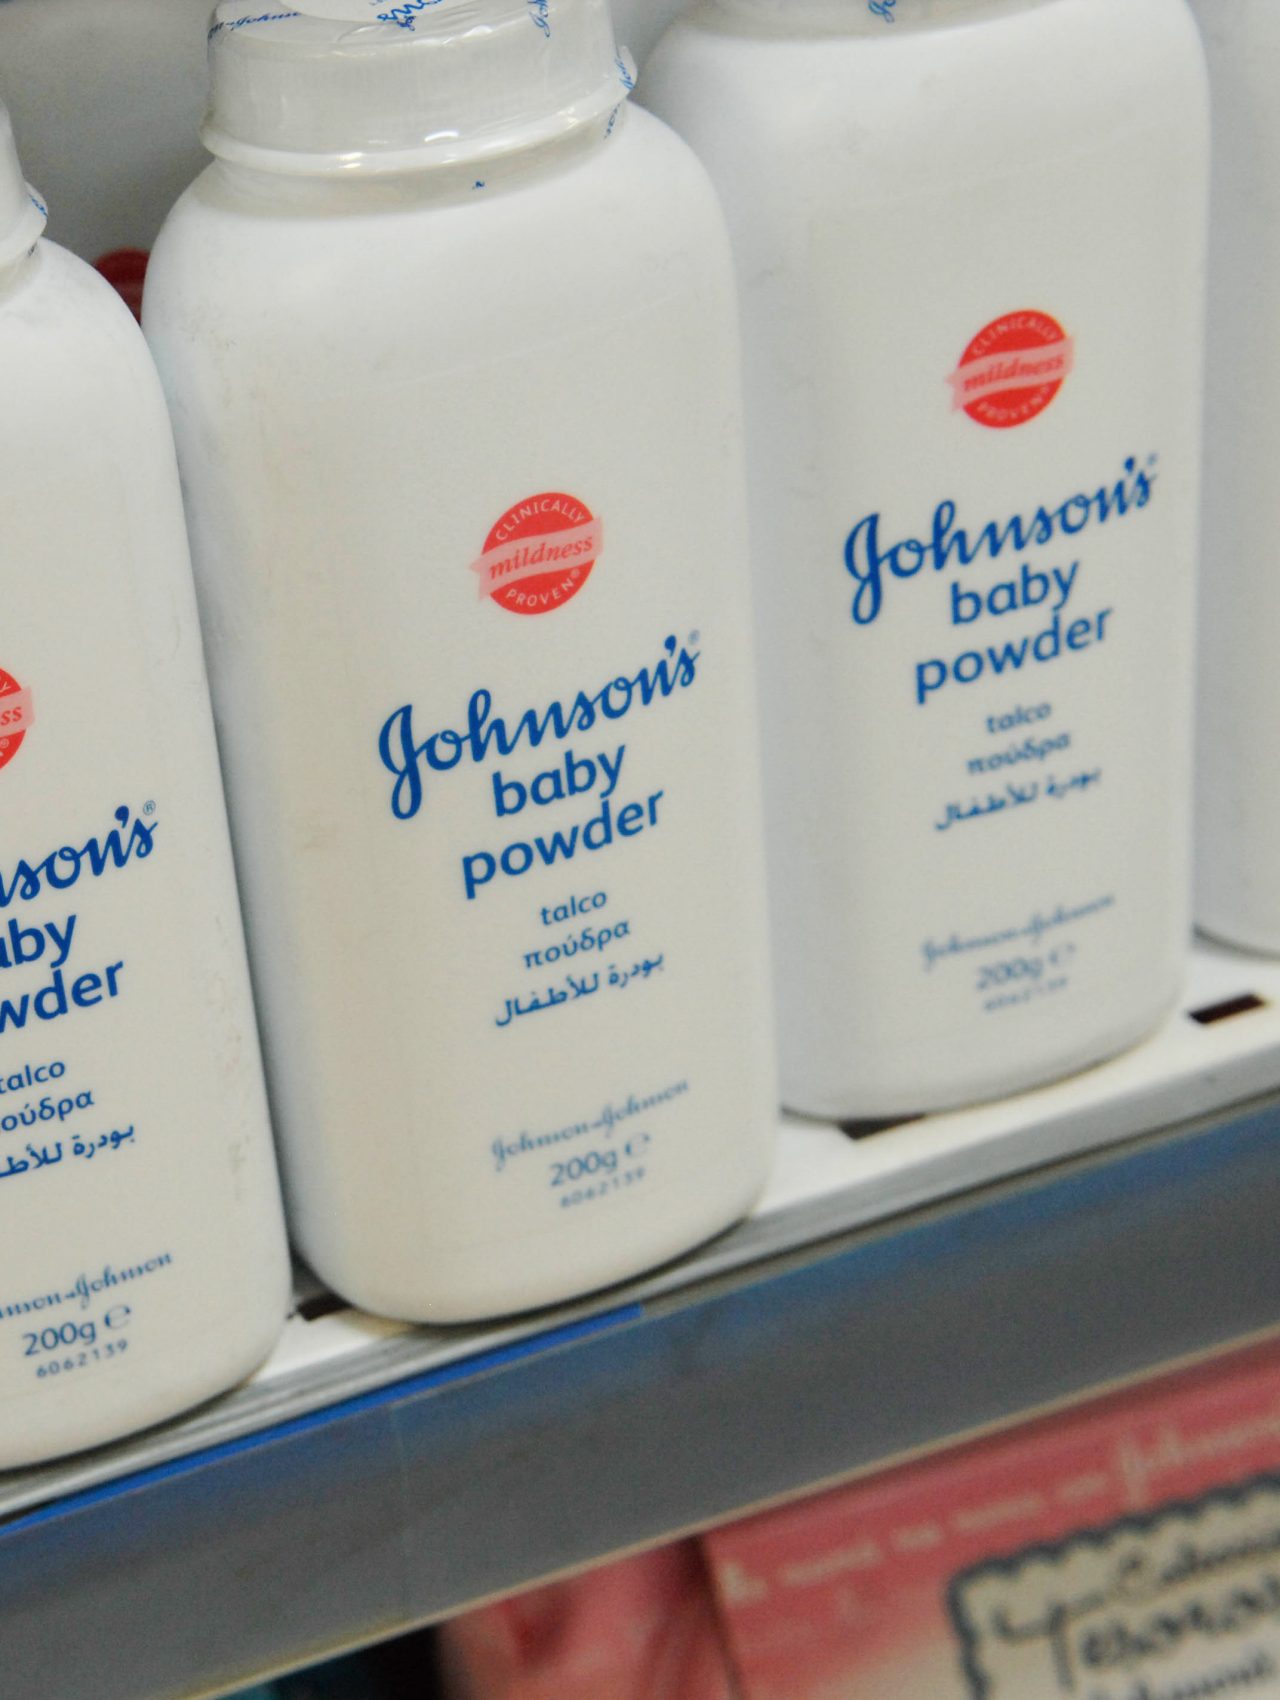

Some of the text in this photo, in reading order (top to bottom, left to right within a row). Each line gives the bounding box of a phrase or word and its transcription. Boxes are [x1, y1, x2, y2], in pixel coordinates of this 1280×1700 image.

[496, 499, 586, 541] CLINICALLY
[488, 535, 594, 580] mildness
[950, 560, 1080, 626] baby
[915, 606, 1114, 705] powder
[491, 744, 625, 817] baby
[462, 790, 664, 900] powder
[540, 891, 607, 926] talco
[72, 1123, 136, 1158] بودرة
[550, 1149, 618, 1187] 200g
[23, 1320, 97, 1357] 200g
